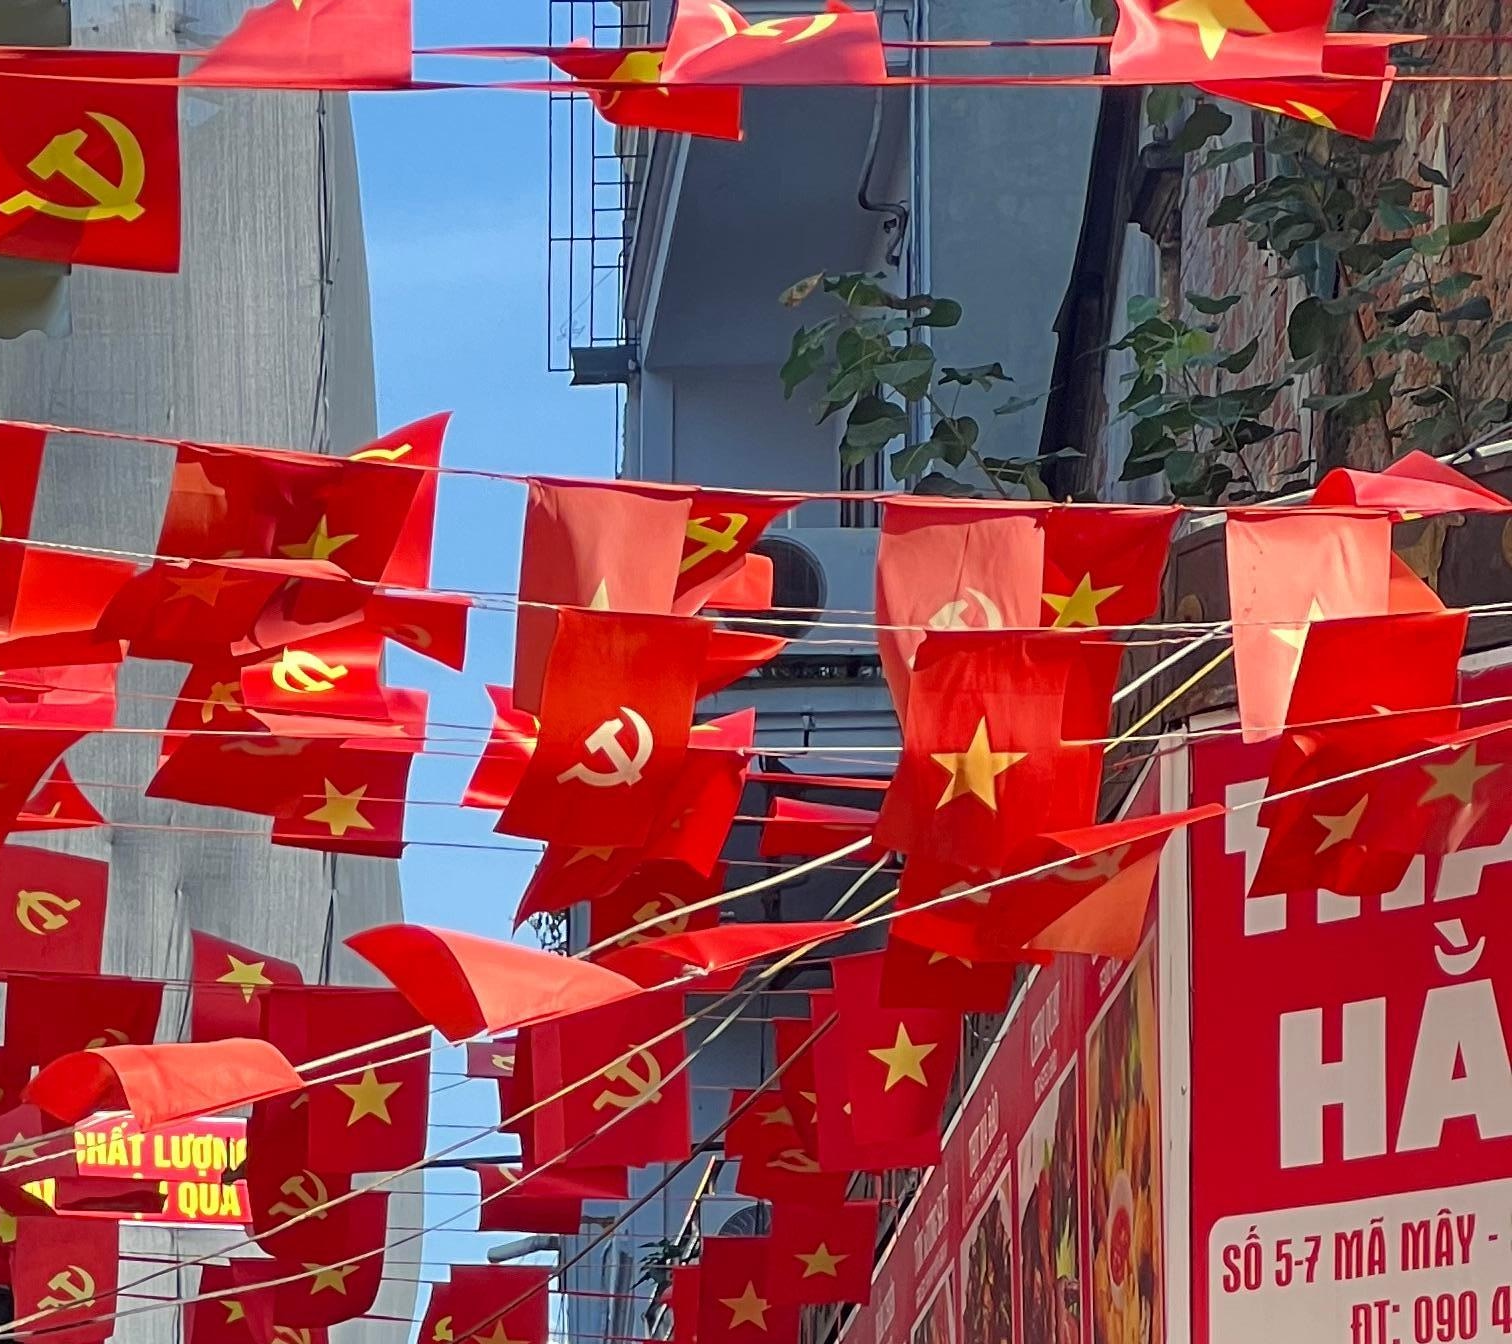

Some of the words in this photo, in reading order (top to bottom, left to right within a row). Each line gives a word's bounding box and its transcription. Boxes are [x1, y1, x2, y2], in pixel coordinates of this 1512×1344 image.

[1222, 1225, 1263, 1293] SỐ
[1275, 1236, 1322, 1287] 5-7
[1334, 1217, 1386, 1280] MÃ
[1401, 1208, 1476, 1271] MÂY
[1414, 1291, 1477, 1344] 090
